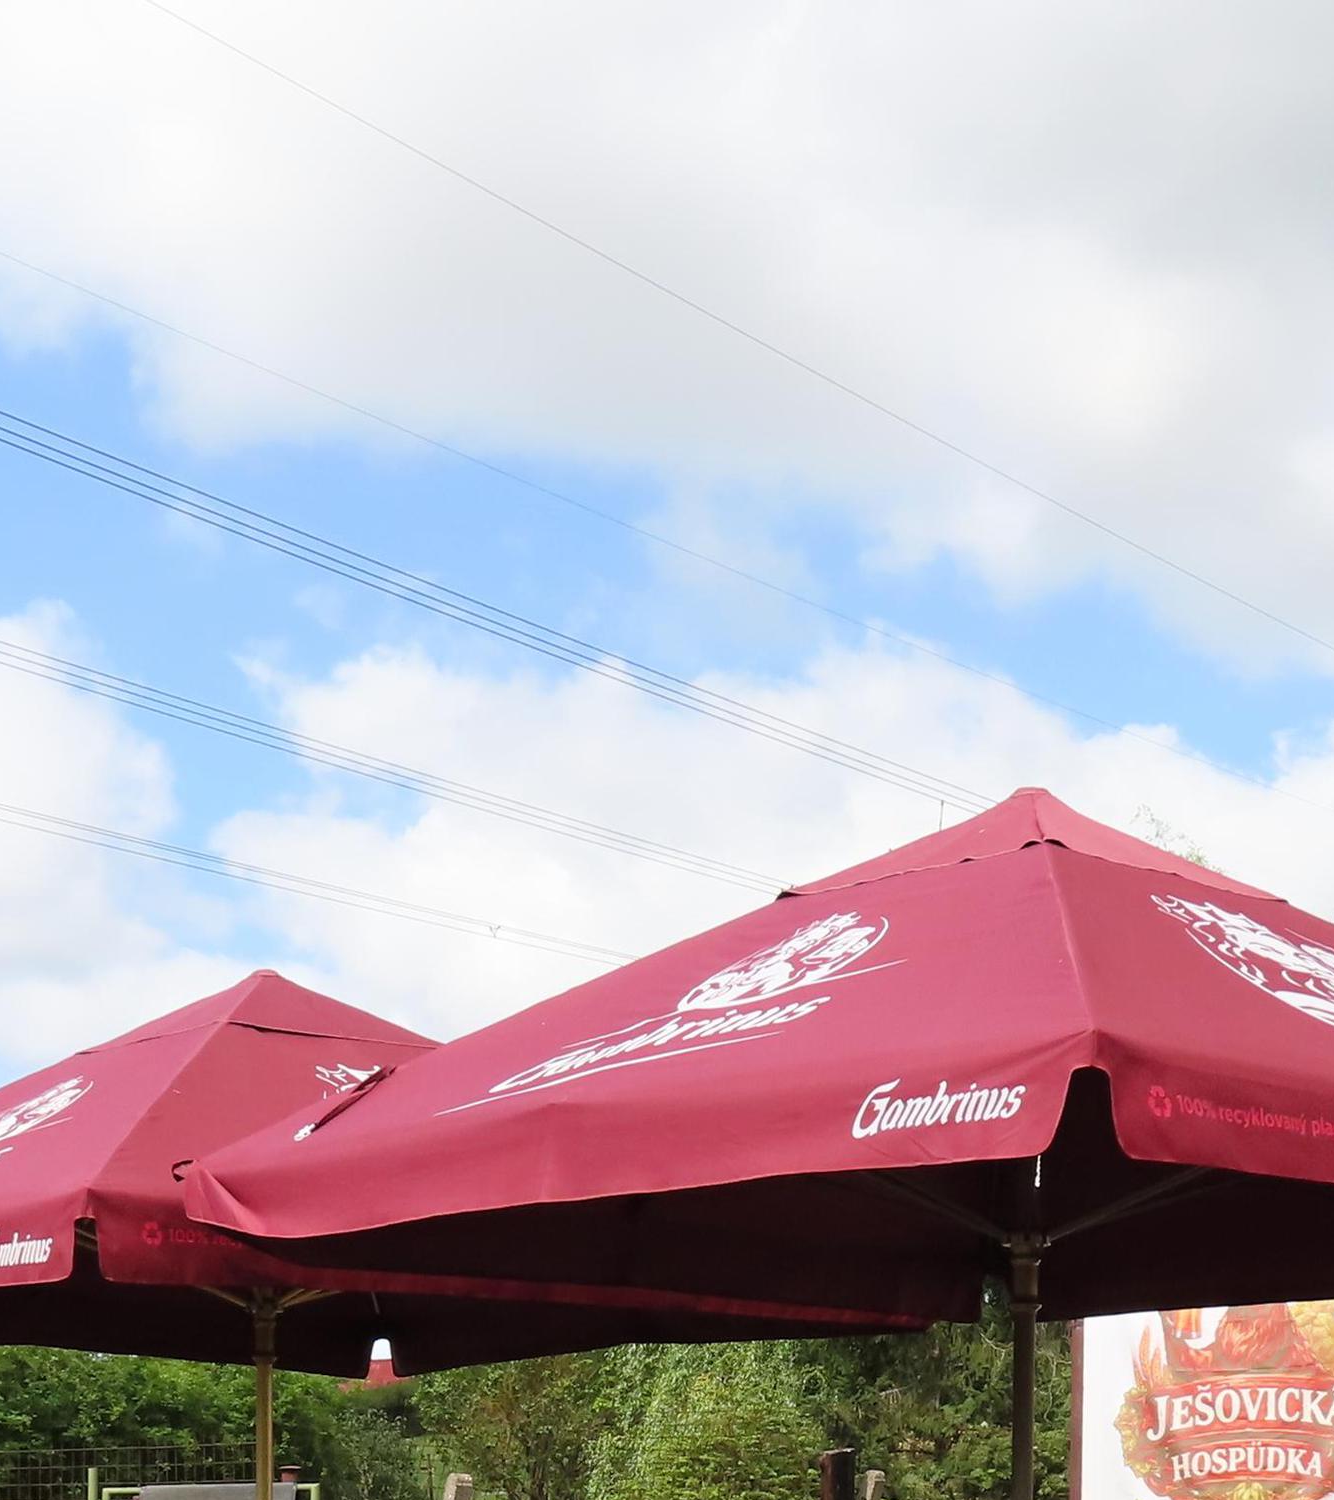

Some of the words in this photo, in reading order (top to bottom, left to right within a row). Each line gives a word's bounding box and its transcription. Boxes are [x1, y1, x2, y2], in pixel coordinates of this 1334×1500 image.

[852, 1078, 1027, 1139] Gambrinus
[1176, 1094, 1216, 1121] 100%
[1218, 1106, 1307, 1136] recyklovaný
